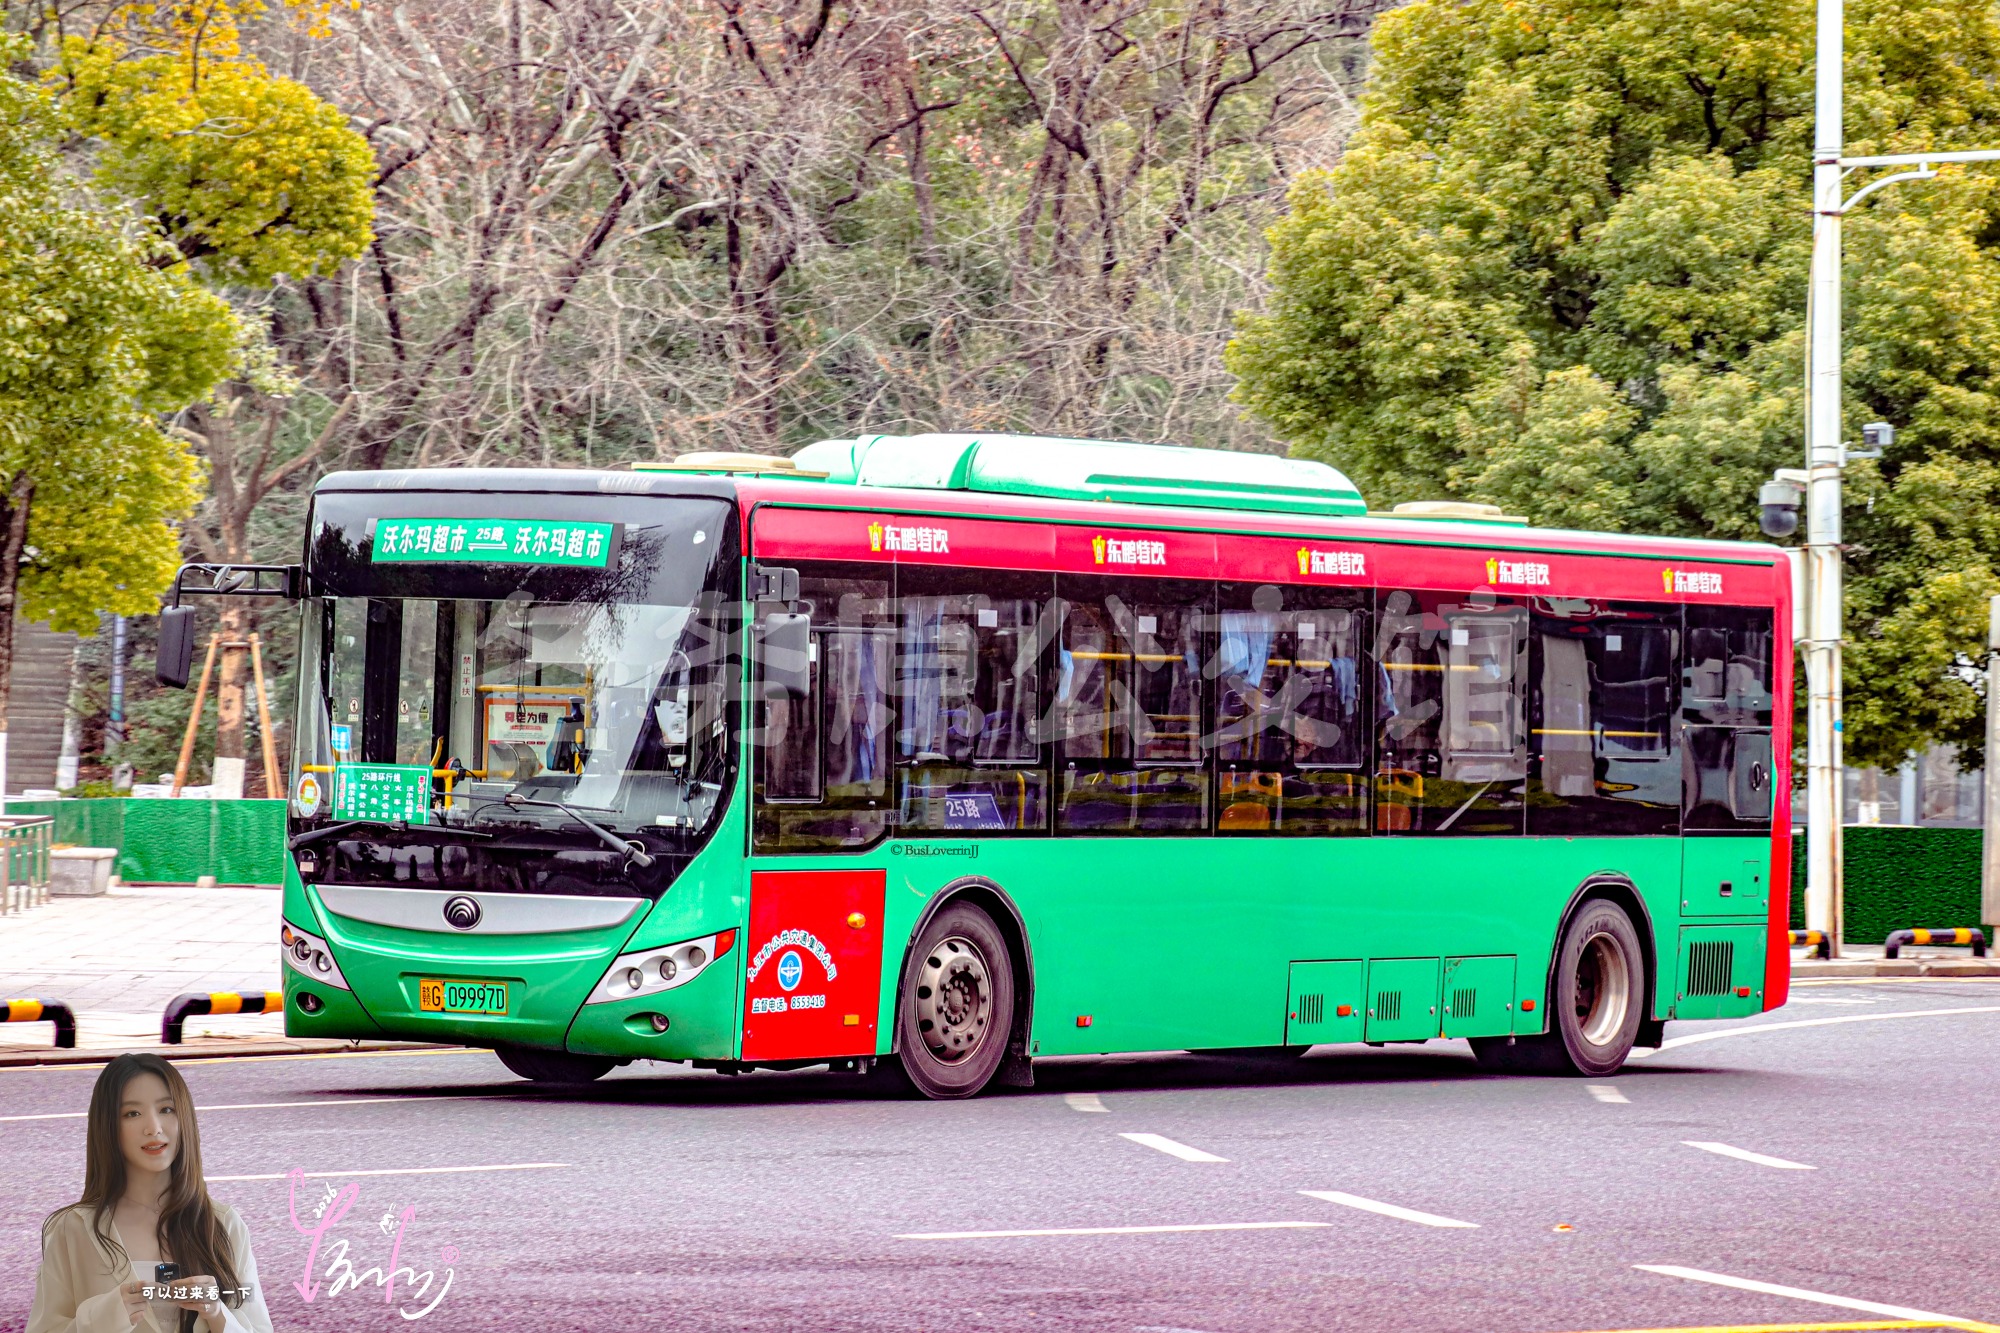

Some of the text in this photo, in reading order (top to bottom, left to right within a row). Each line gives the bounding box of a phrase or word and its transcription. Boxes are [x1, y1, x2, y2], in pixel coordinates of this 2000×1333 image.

[382, 524, 604, 559] 沃尔玛超市 25路 沃尔玛超市
[884, 524, 949, 553] 东鹏特饮
[1107, 538, 1166, 565] 东鹏特饮
[1310, 550, 1366, 576] 东鹏特饮
[1498, 560, 1550, 586] 东鹏特饮
[1674, 571, 1723, 594] 东鹏特饮
[462, 655, 471, 696] 禁止手扶
[361, 772, 401, 783] 25路环行线
[381, 784, 390, 819] 公交公司
[945, 798, 981, 819] 25路
[747, 929, 838, 982] 九江市公共交通集团公司
[790, 994, 826, 1010] 8553416
